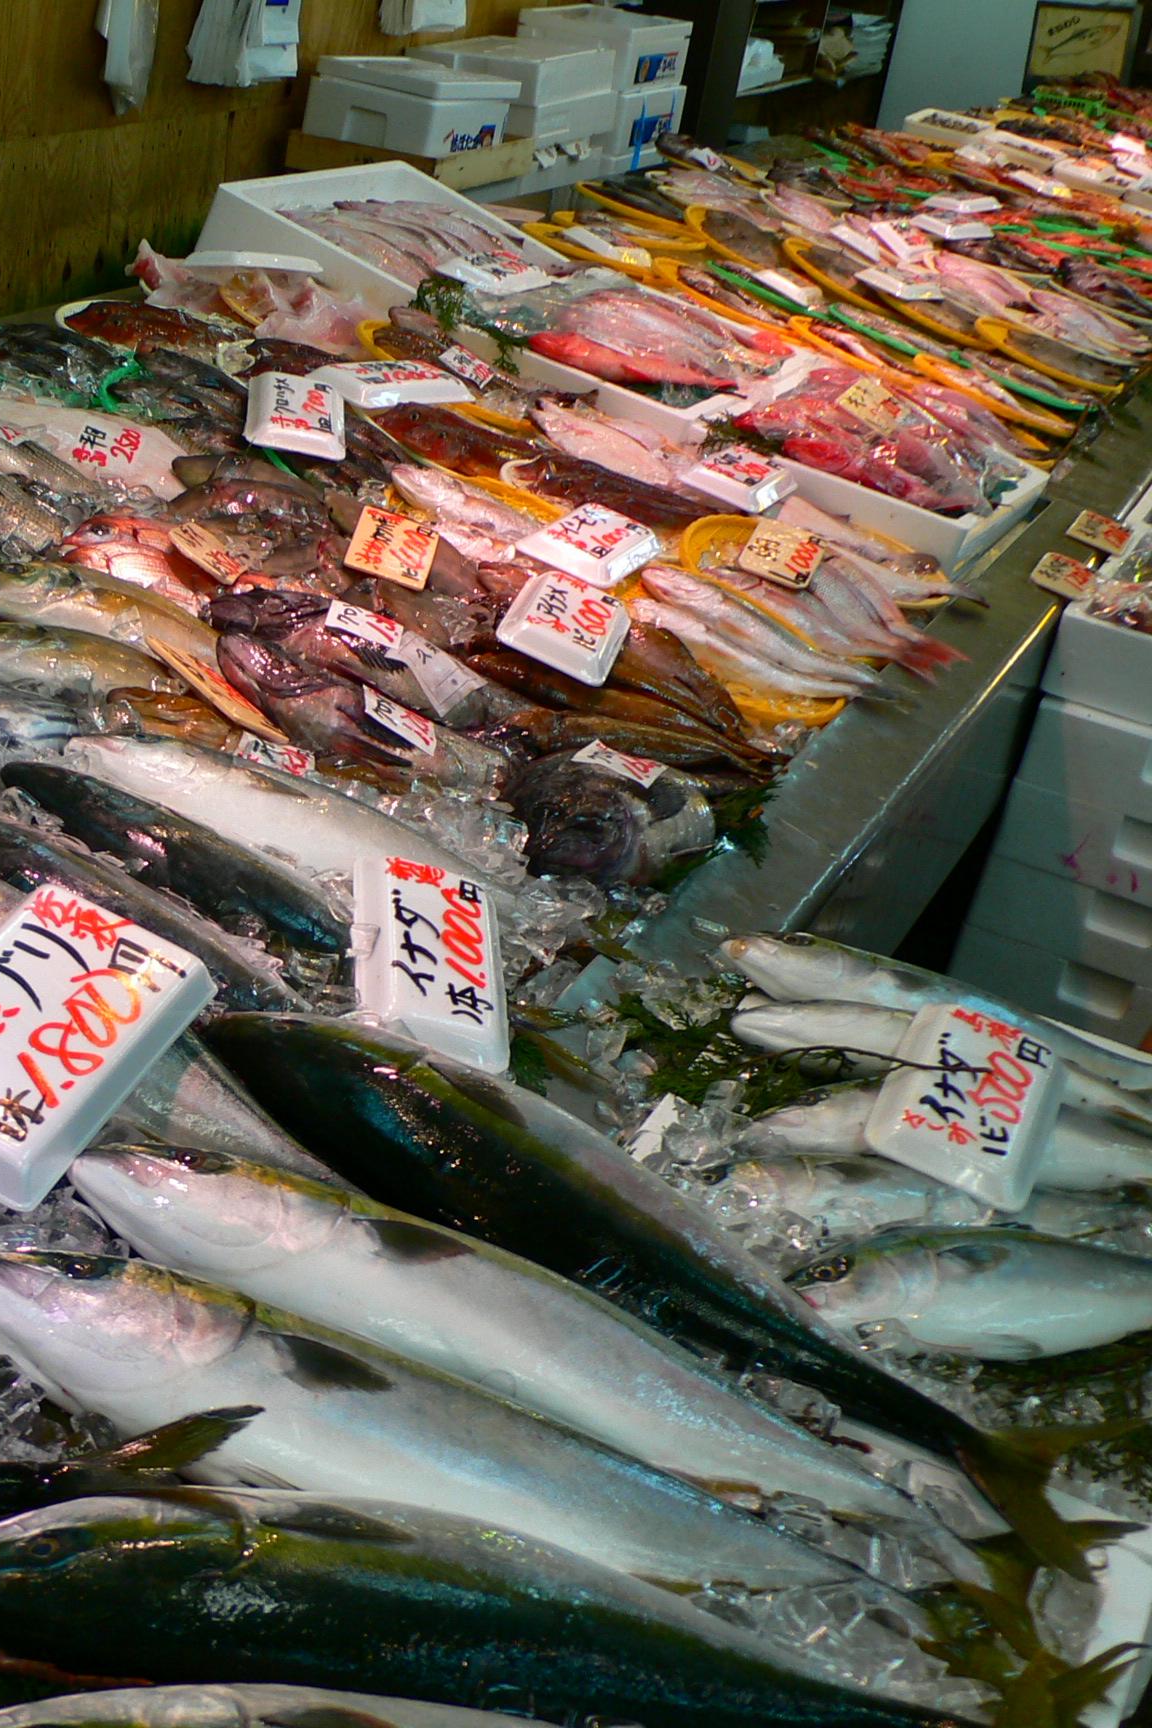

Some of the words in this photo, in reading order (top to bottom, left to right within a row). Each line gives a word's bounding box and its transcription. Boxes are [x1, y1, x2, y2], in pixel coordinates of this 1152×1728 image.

[536, 584, 569, 620] アイナメ
[391, 888, 442, 997] イナダ
[918, 1031, 979, 1124] イナダ
